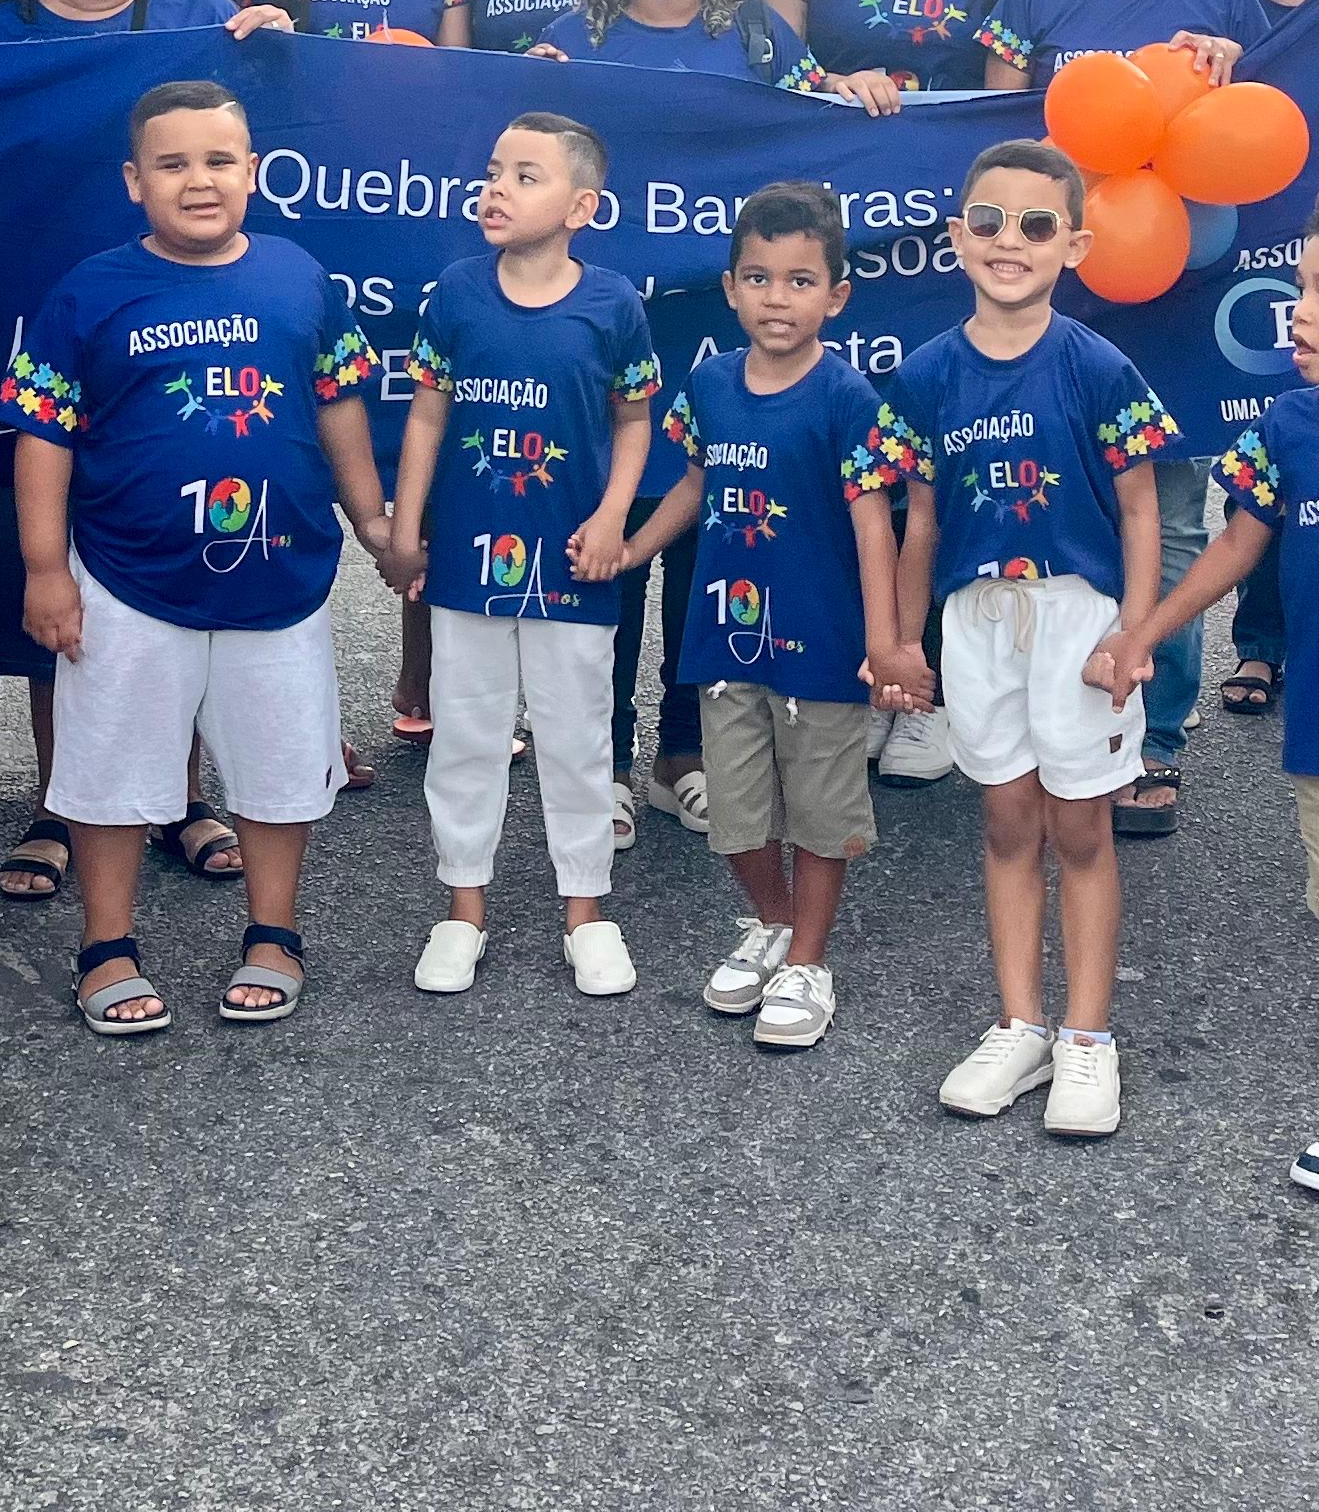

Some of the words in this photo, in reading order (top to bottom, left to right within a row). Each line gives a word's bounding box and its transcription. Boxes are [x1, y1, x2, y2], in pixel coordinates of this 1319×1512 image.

[128, 313, 259, 357] ASSOCIAÇÃO
[206, 365, 261, 398] ELO
[1220, 397, 1261, 422] UMA
[492, 428, 544, 460] ELO
[989, 459, 1039, 489] ELO
[180, 476, 252, 535] 10
[723, 486, 767, 518] ELO
[473, 533, 527, 587] 10
[706, 578, 760, 626] 10
